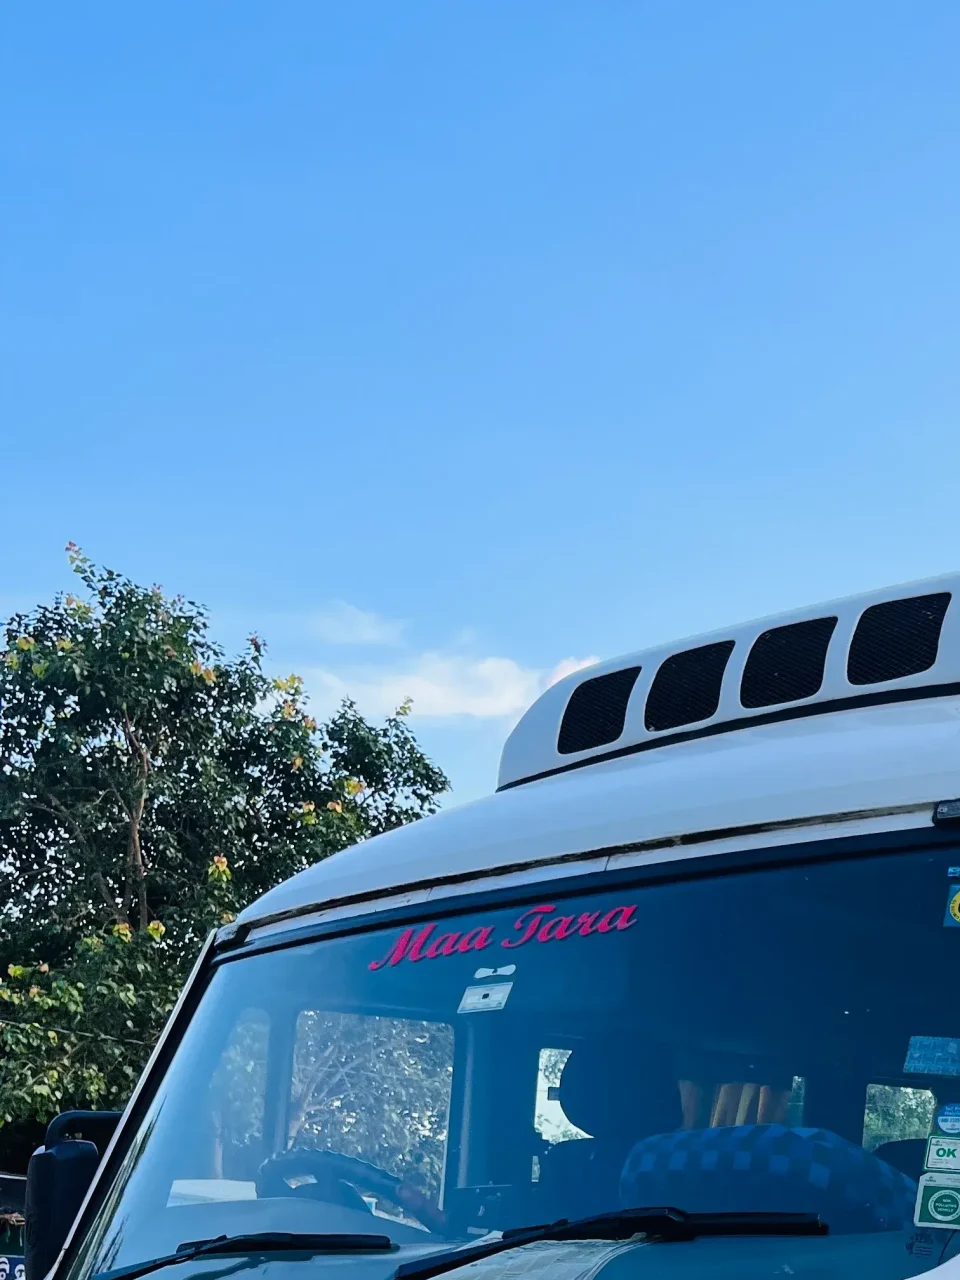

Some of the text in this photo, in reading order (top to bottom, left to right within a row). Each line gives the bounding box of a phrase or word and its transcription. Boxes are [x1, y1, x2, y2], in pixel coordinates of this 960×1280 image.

[367, 904, 638, 971] Maa Tara
[935, 1147, 957, 1158] OK
